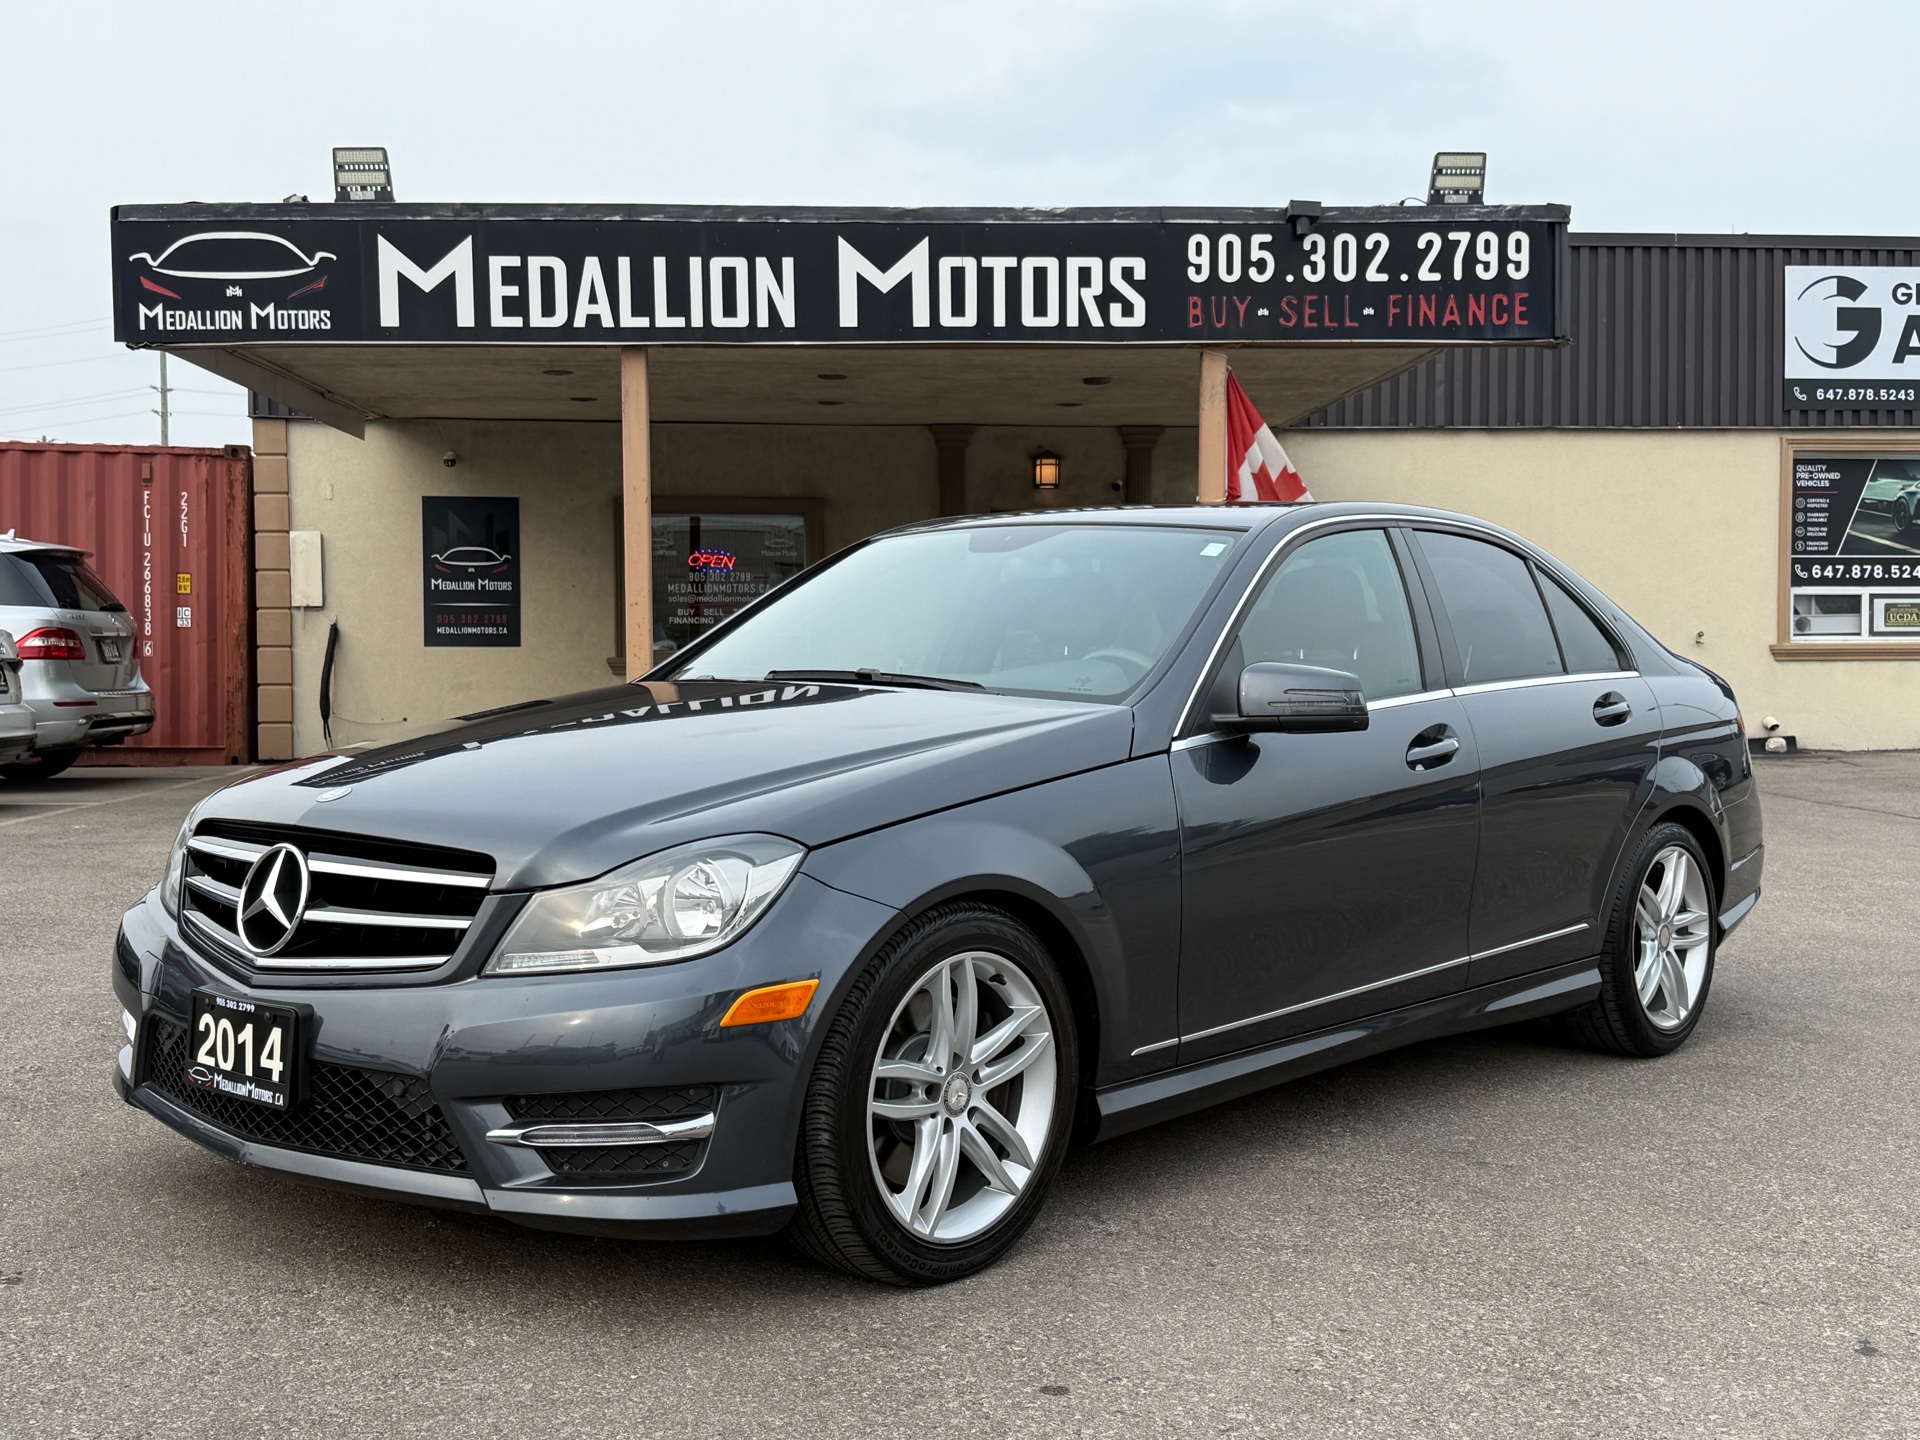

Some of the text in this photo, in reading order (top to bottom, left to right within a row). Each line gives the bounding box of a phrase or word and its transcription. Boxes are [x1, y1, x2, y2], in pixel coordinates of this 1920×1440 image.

[1187, 231, 1530, 283] 905.302.2799
[377, 234, 1147, 329] MEDALLION MOTORS
[1892, 282, 1920, 305] G
[139, 302, 331, 330] MEDALLION MOTORS
[1187, 292, 1529, 328] BUY SELL FINANCE
[1816, 388, 1915, 401] 647.878.5243
[1796, 472, 1841, 480] PRE-OWNED
[180, 491, 189, 547] 22G1
[687, 553, 736, 568] OPEN
[431, 578, 513, 591] MEDALLION MOTORS
[677, 608, 696, 616] BUY
[703, 608, 725, 616] SELL
[1889, 613, 1918, 621] UCDA
[668, 617, 715, 625] FINANCING
[436, 626, 508, 635] MEDALLIONMOTORS.CA
[196, 1012, 284, 1083] 2014
